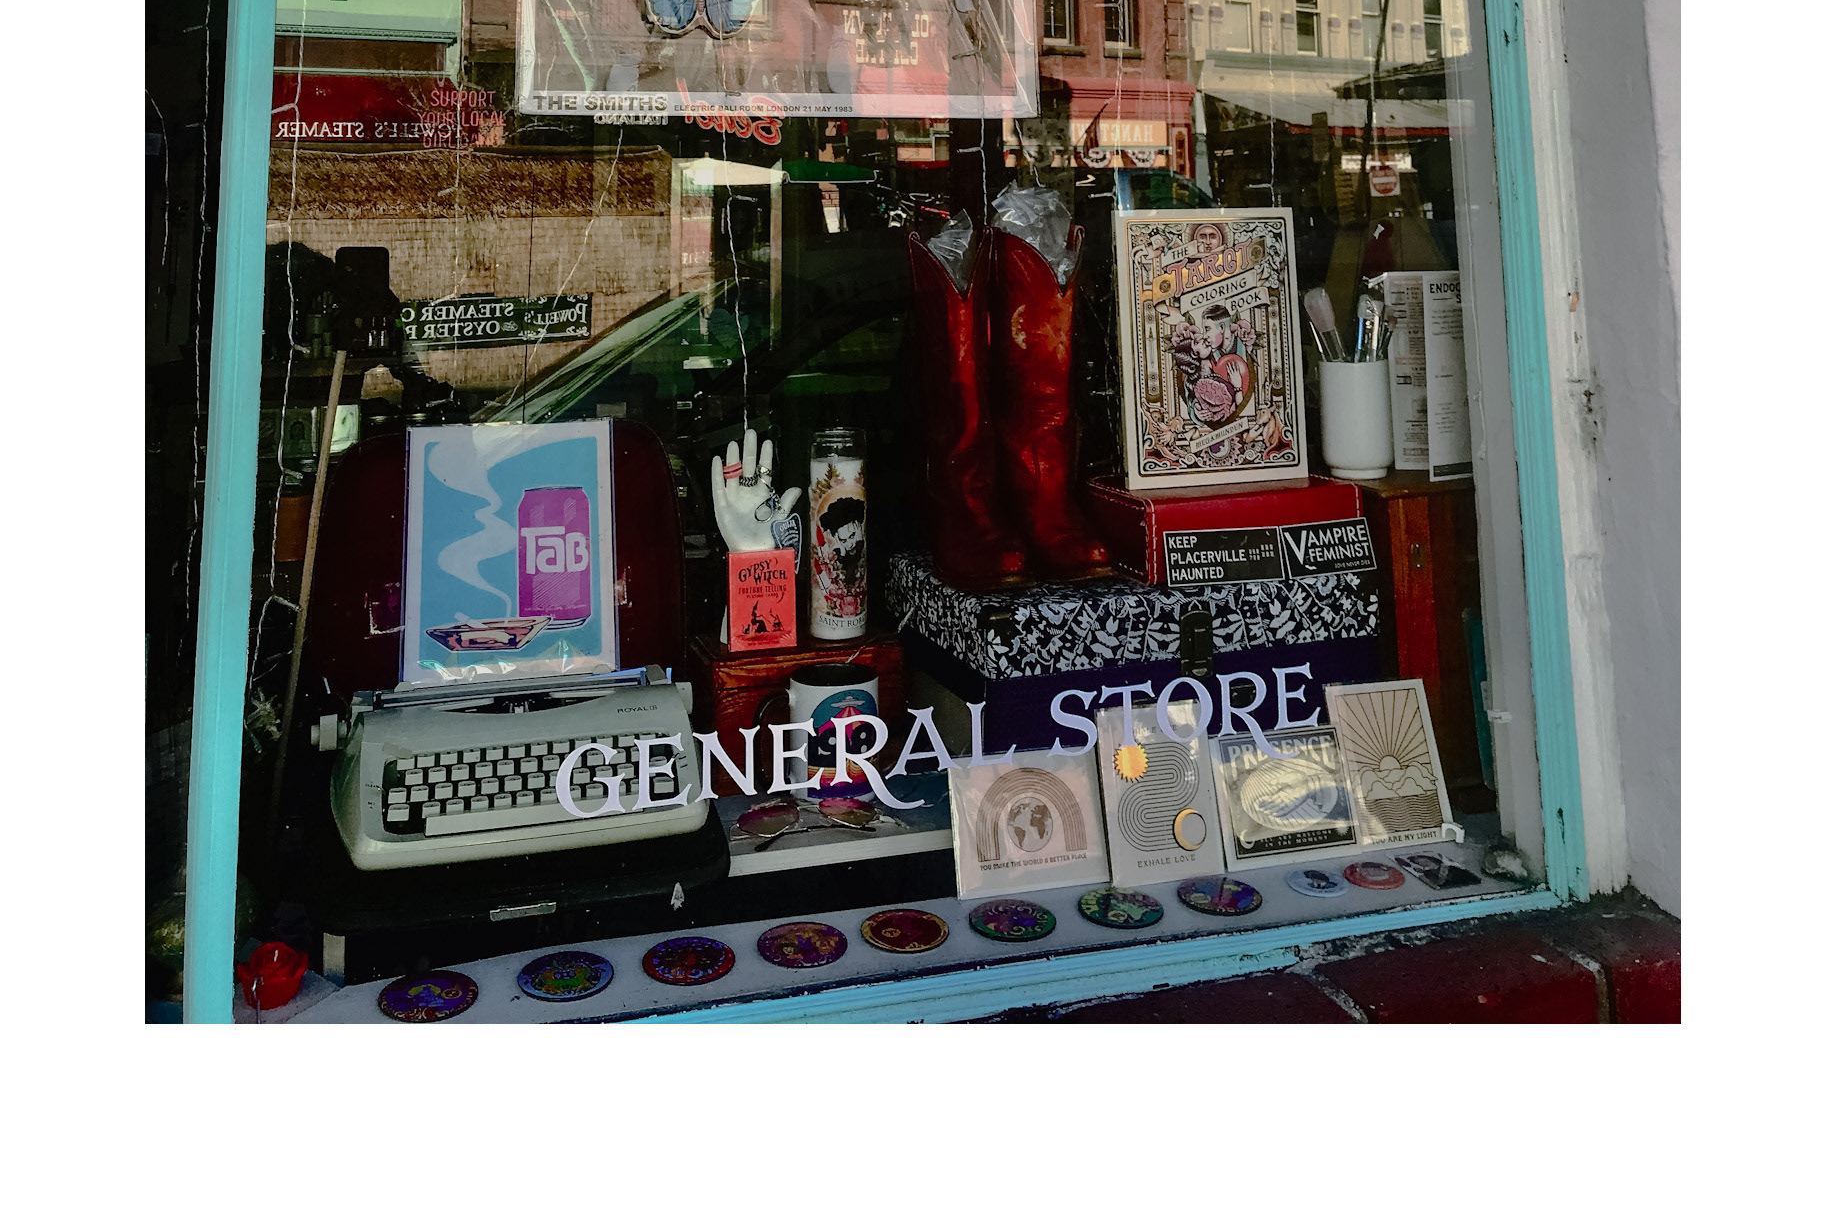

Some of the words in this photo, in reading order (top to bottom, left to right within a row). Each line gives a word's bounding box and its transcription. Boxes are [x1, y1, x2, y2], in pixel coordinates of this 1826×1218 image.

[430, 90, 496, 108] SUPPORT
[533, 95, 577, 112] THE
[584, 95, 669, 112] SMITHS
[674, 104, 716, 113] ELECTRIC
[766, 104, 800, 113] LONDON
[802, 104, 812, 113] 21
[814, 104, 831, 113] MAY
[834, 104, 853, 113] 1983
[418, 111, 456, 128] YOUR
[462, 110, 507, 127] LOCAL
[1170, 246, 1189, 260] THE
[1166, 239, 1251, 298] TAROT
[1189, 277, 1247, 308] COLORING
[1230, 290, 1263, 312] BOOK
[1168, 535, 1198, 549] KEEP
[1283, 524, 1368, 566] VAMPIRE
[1170, 548, 1247, 565] PLACERVILLE
[1308, 542, 1370, 563] FEMINIST
[738, 558, 772, 583] GYPSY
[753, 570, 787, 586] WITCH
[1172, 566, 1225, 581] HAUNTED
[765, 584, 787, 592] TELLING
[819, 615, 845, 628] SAINT
[617, 706, 649, 714] ROYAL
[555, 702, 1017, 819] GENERAL
[1047, 662, 1322, 759] STORE
[1388, 835, 1403, 843] ARE
[1405, 833, 1415, 841] MY
[1417, 831, 1437, 840] LIGHT
[993, 862, 1009, 870] MAKE
[1011, 860, 1022, 868] THE
[1023, 858, 1043, 866] WORLD
[1049, 855, 1070, 863] BETTER
[1071, 852, 1087, 860] PLACE
[1137, 856, 1172, 869] EXHALE
[1173, 853, 1196, 864] LOVE
